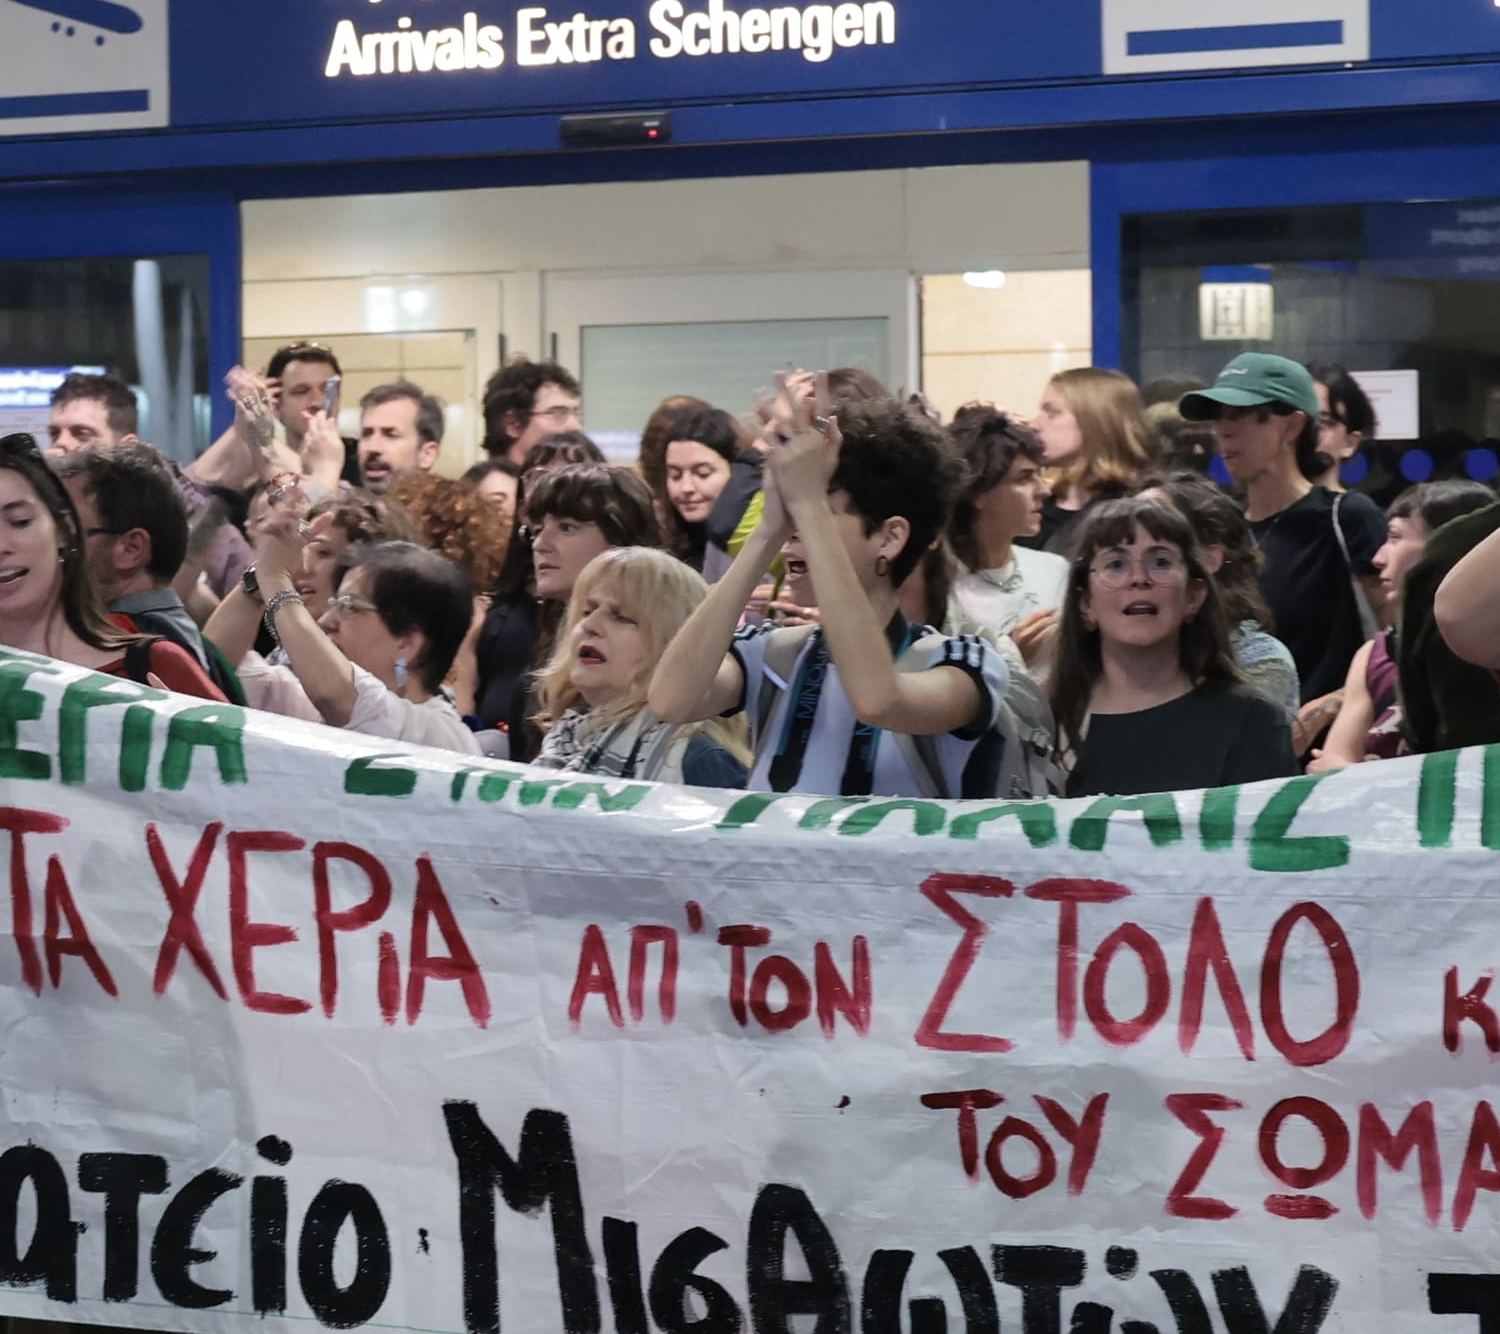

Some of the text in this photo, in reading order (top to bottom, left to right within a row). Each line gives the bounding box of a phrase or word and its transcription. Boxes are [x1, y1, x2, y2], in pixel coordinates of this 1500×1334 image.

[324, 11, 506, 78] Arrivals
[515, 6, 636, 67] Extra
[145, 821, 491, 1029] ΧΕΡΙΑ
[914, 871, 1361, 1068] ΣΤΟΛΟ
[919, 1088, 1110, 1200] ΤΟΥ
